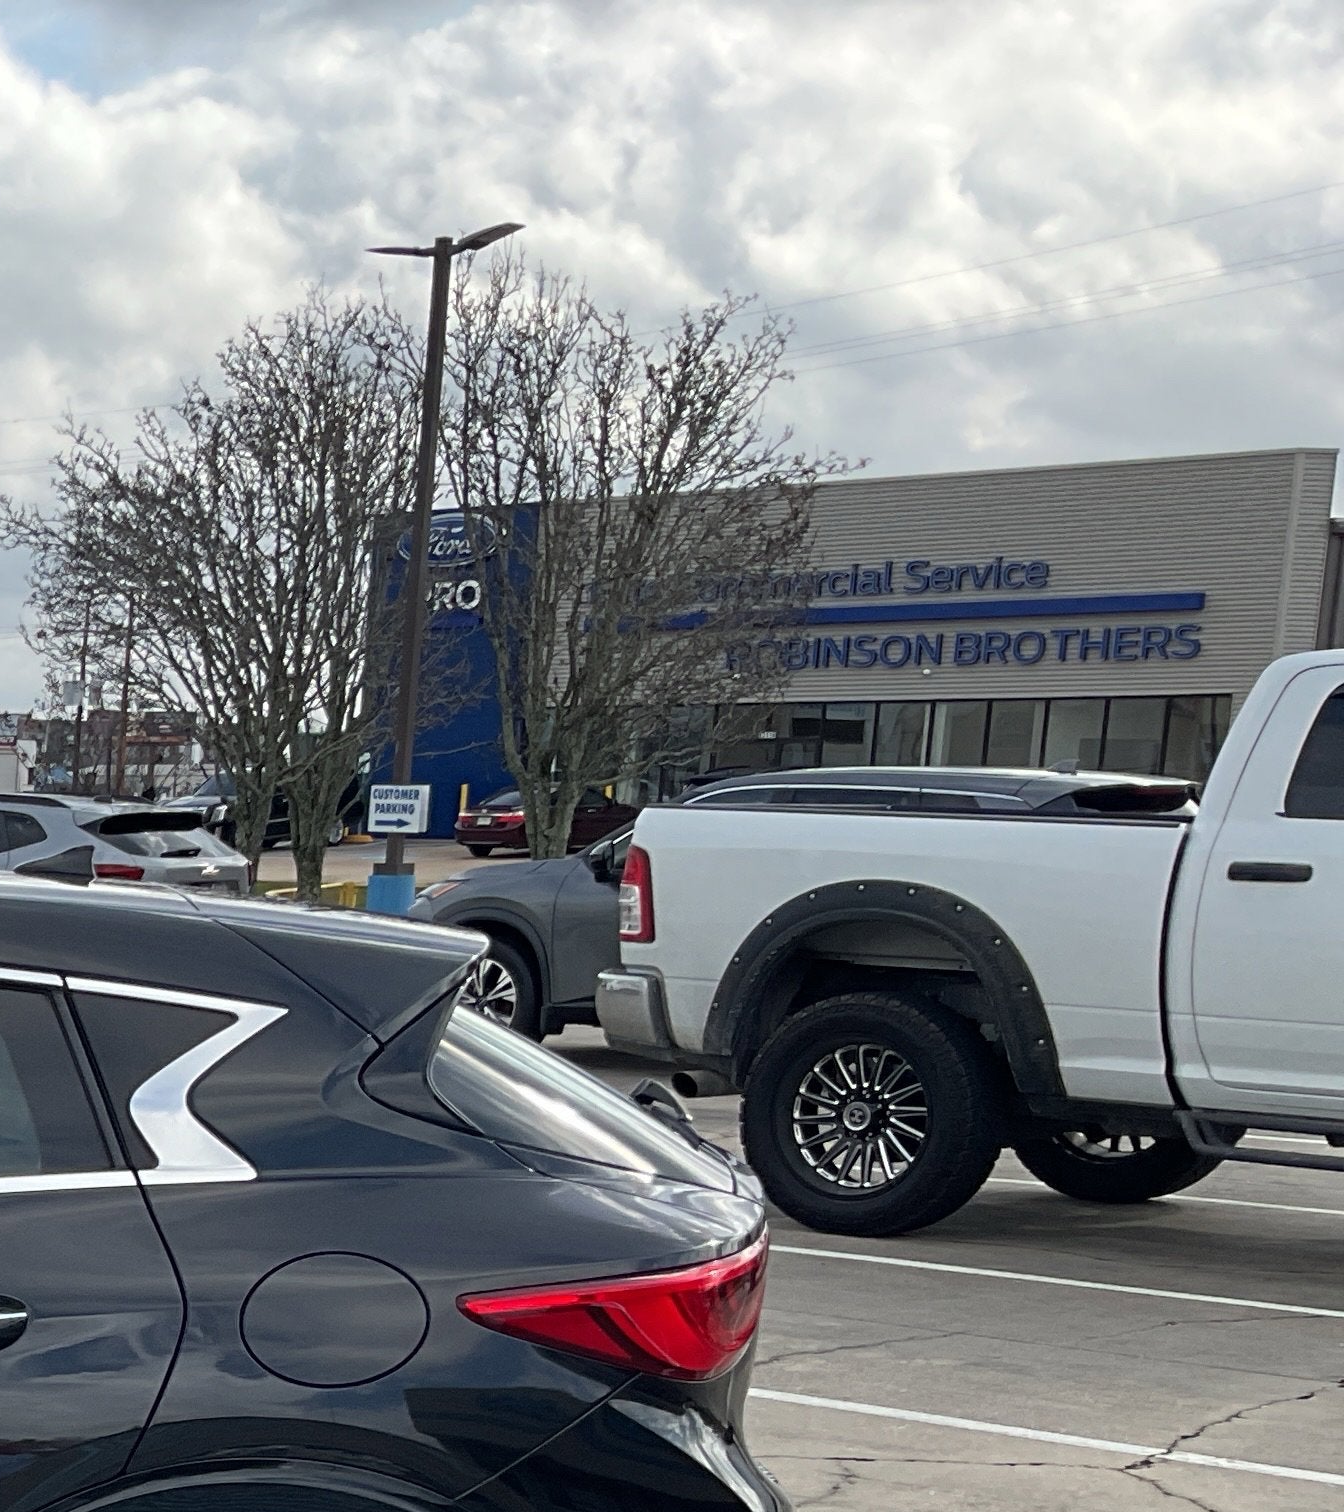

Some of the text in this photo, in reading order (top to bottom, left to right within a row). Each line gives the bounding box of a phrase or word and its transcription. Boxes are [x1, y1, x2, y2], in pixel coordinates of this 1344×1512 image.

[904, 556, 1050, 595] Service
[426, 579, 481, 610] RO
[954, 624, 1202, 667] BROTHERS
[373, 789, 420, 800] CUSTOMER
[374, 803, 415, 815] PARKING
